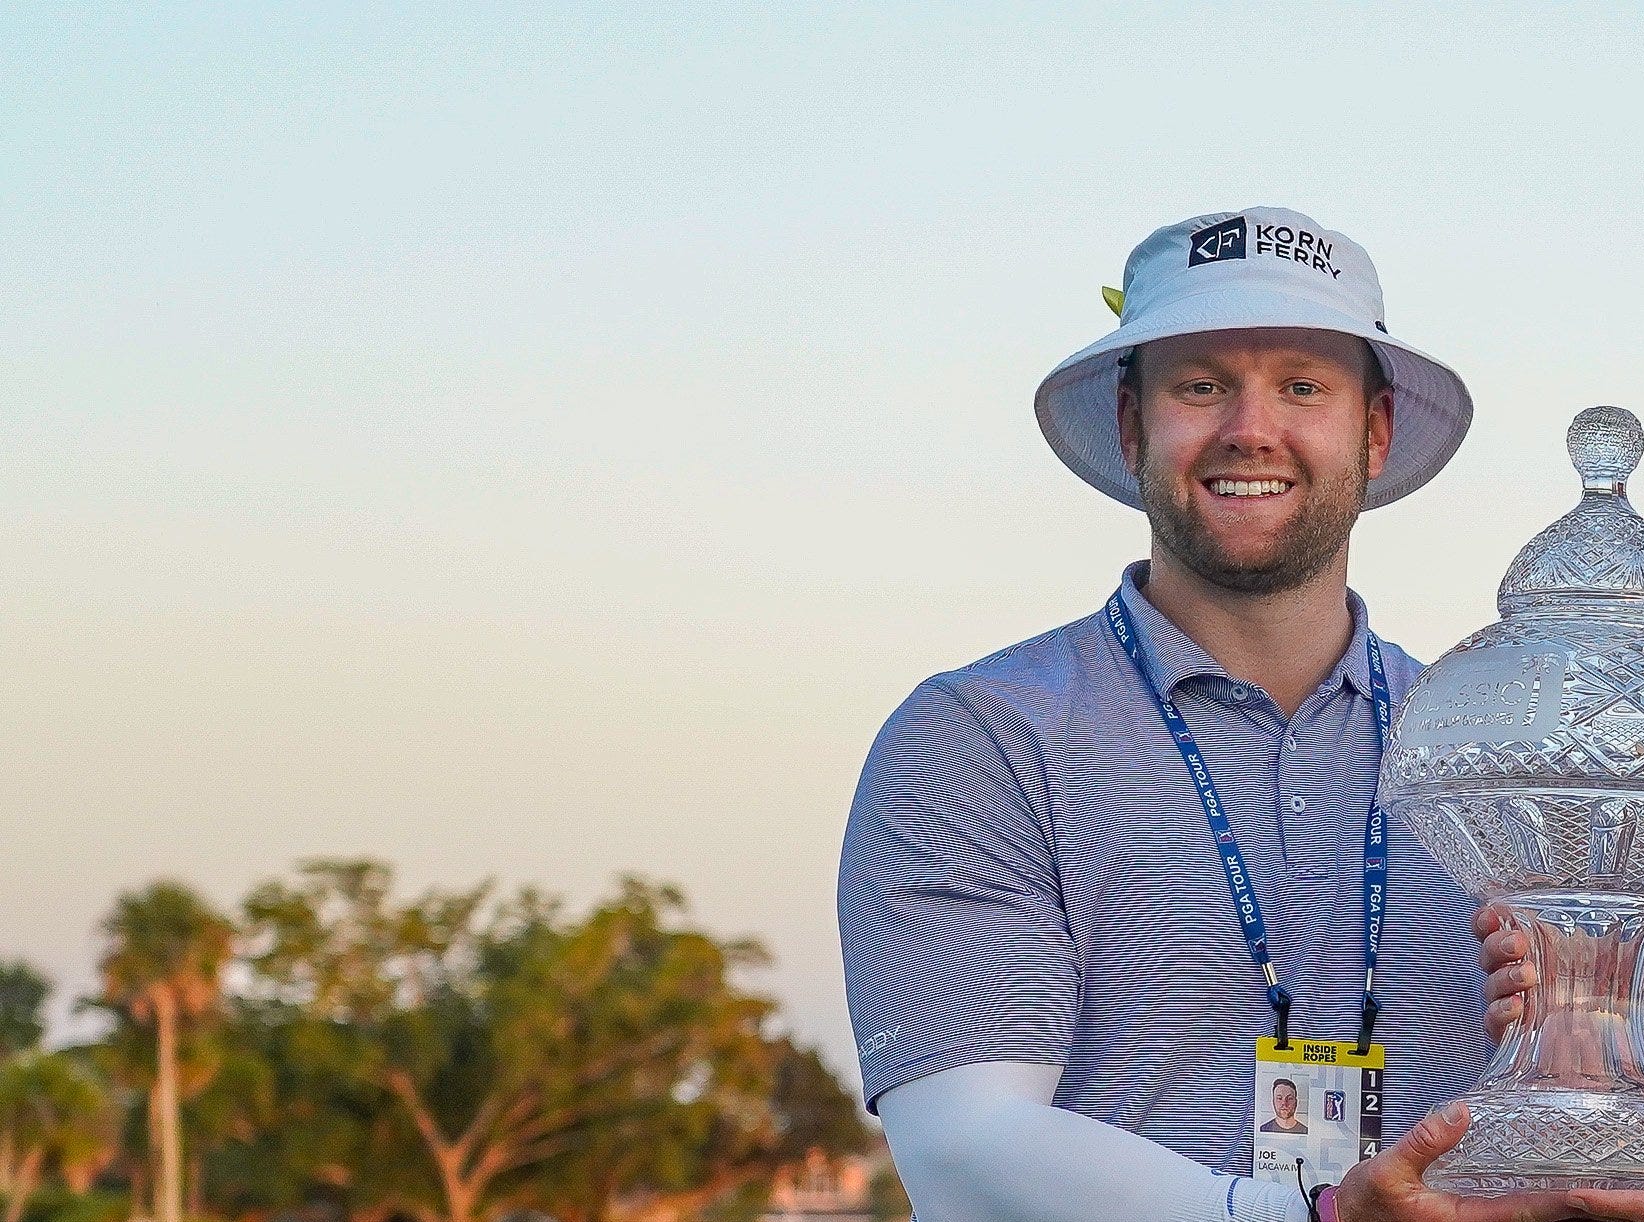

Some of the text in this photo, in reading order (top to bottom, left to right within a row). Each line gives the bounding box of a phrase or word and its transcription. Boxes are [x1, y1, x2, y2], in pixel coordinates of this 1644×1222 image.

[1255, 224, 1333, 261] KORN
[1256, 241, 1342, 280] FERRY
[1114, 617, 1130, 644] PGA
[1378, 699, 1388, 722] PGA
[1187, 753, 1221, 817] PGA TOUR
[1370, 808, 1382, 846] TOUR
[1226, 855, 1257, 924] PGA TOUR
[1369, 884, 1382, 954] PGA TOUR
[1303, 1043, 1338, 1055] INSIDE
[1303, 1052, 1337, 1063] ROPES
[1368, 1070, 1377, 1088] 1
[1365, 1094, 1379, 1112] 2
[1258, 1150, 1277, 1160] JOE
[1363, 1141, 1378, 1160] 4
[1258, 1162, 1291, 1172] LACAVA
